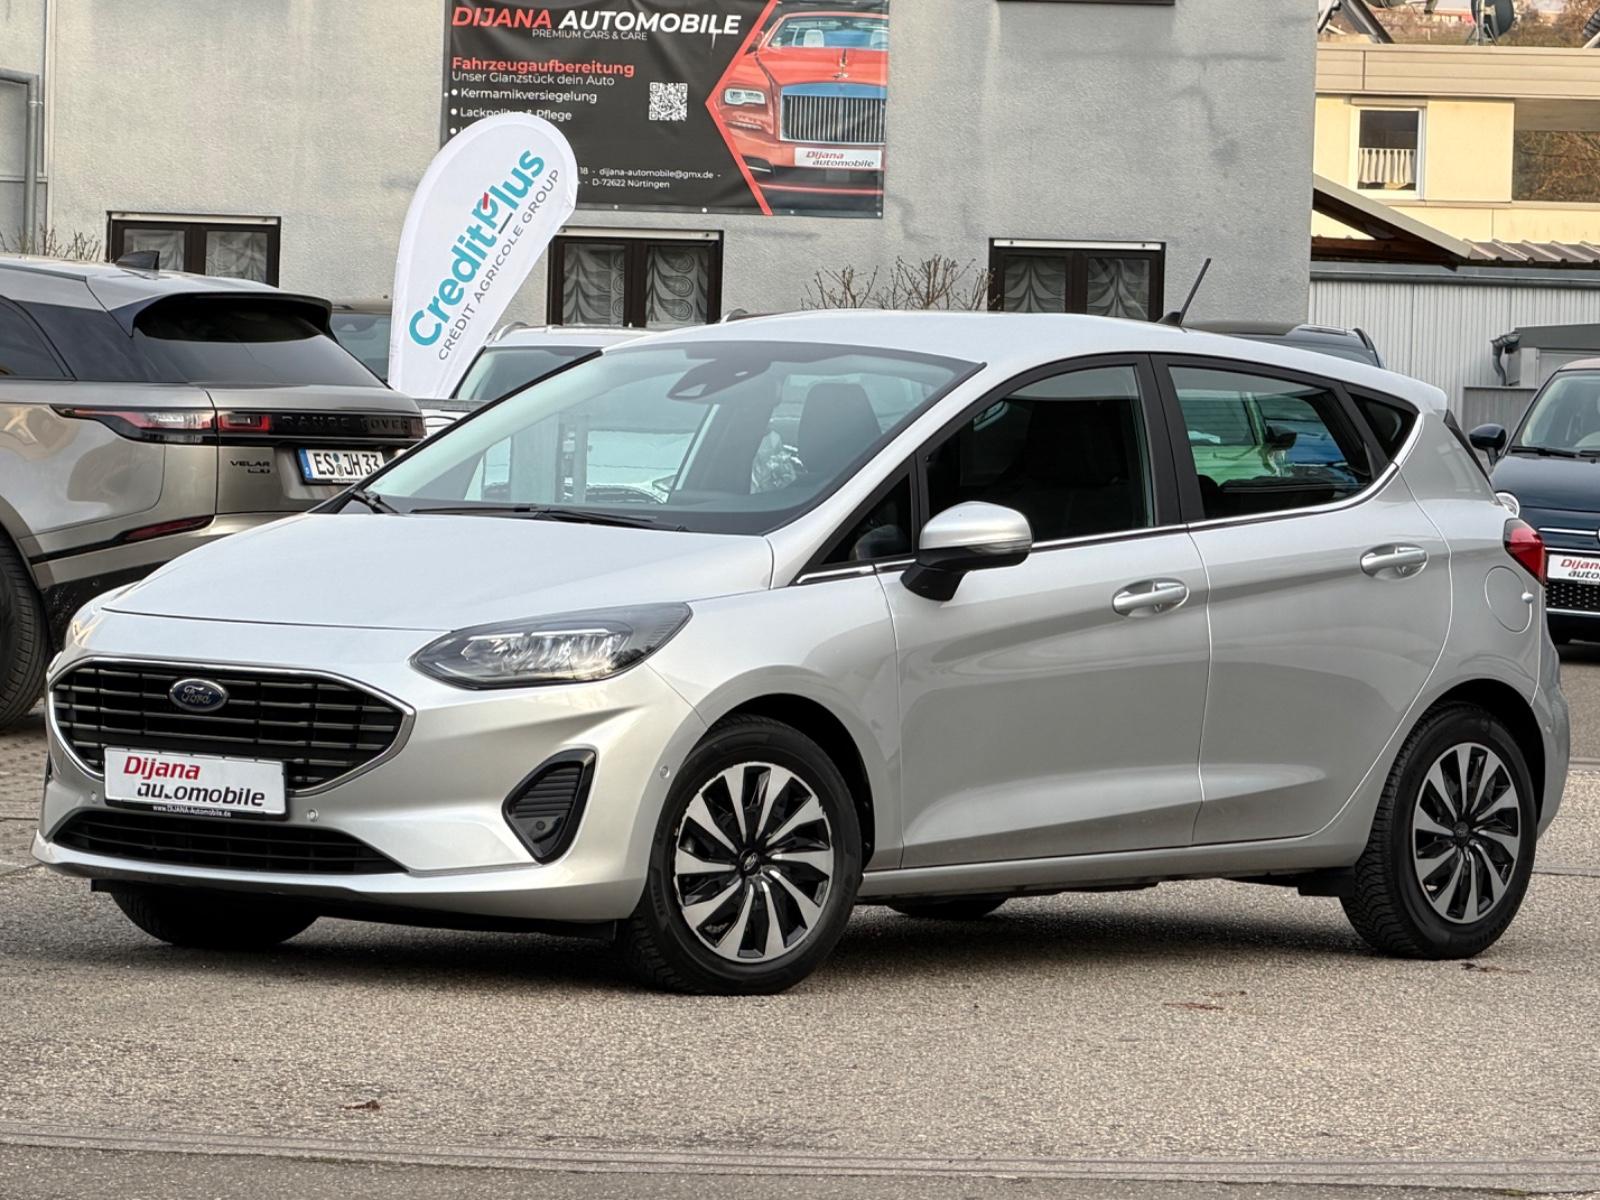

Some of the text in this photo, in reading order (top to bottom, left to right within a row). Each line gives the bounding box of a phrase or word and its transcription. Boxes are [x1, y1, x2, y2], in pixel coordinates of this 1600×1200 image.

[452, 6, 742, 35] DIJANA AUTOMOBILE
[532, 29, 648, 41] PREMIUM CARS & CARE
[452, 57, 635, 78] Fahrzeugaufbereitung
[452, 71, 615, 87] Unser Glanzstück dein Auto
[460, 87, 598, 105] Kermamikversiegelung
[536, 108, 573, 122] Pflege
[805, 150, 845, 160] Dijana
[812, 159, 874, 168] automobile
[592, 177, 626, 187] D-72622
[627, 178, 670, 190] Nürtingen
[438, 168, 561, 362] CRÉDIT AGRICOLE GROUP
[313, 452, 335, 476] ES
[342, 453, 363, 476] JH
[1560, 558, 1600, 570] Dijan
[1568, 570, 1600, 579] auto
[123, 756, 201, 781] Dijana
